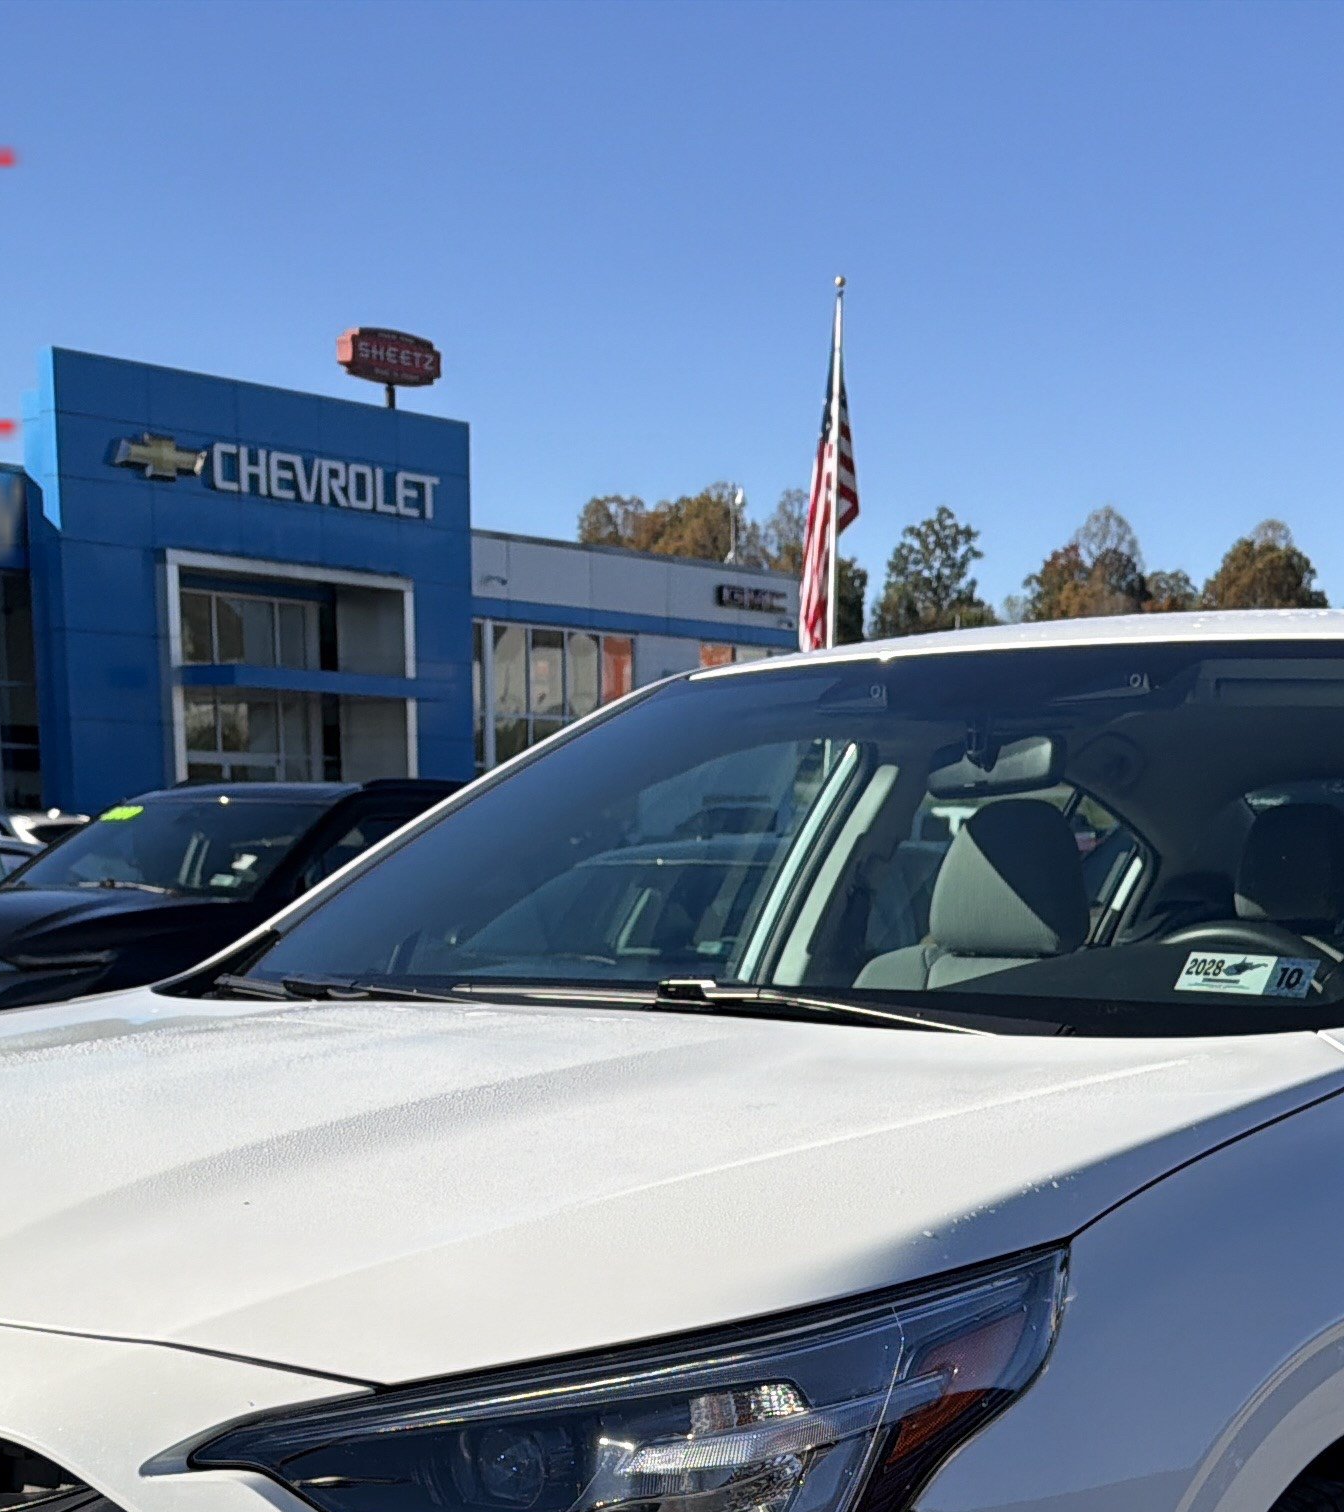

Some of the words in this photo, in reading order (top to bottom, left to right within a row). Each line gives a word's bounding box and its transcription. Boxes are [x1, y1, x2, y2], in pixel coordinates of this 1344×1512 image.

[358, 340, 435, 371] SHEETZ
[212, 442, 440, 519] CHEVROLET
[1185, 958, 1225, 976] 2028
[1276, 967, 1304, 990] 10
